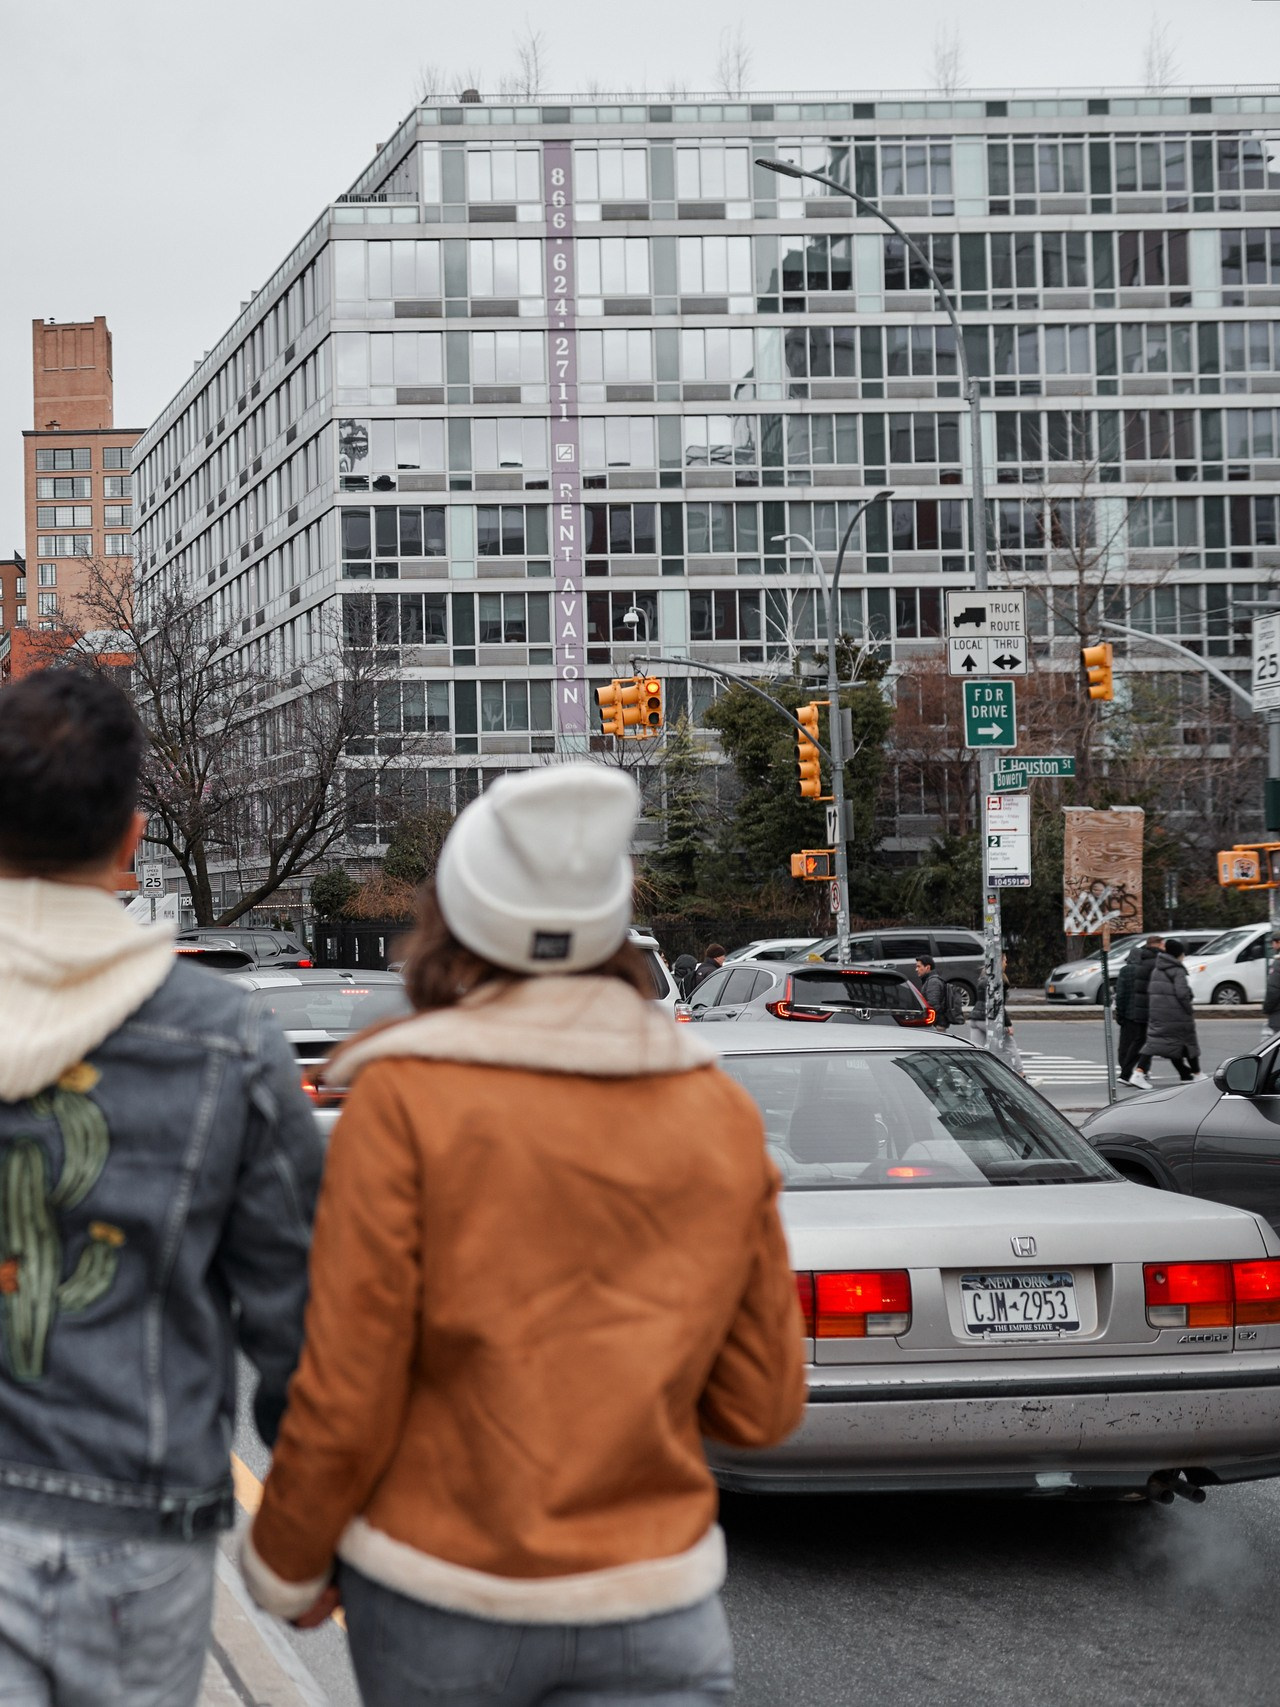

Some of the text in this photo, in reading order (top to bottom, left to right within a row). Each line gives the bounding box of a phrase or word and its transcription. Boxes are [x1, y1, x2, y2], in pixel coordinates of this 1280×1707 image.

[559, 483, 574, 562] RENT
[989, 603, 1020, 613] TRUCK
[990, 621, 1020, 631] ROUTE
[561, 578, 578, 704] AVALON
[954, 640, 983, 650] LOCAL
[994, 639, 1019, 649] THRU
[1257, 653, 1279, 680] 25
[975, 689, 1003, 701] FDR
[972, 705, 1008, 718] DRIVE
[1011, 759, 1059, 774] Houston
[1063, 759, 1072, 769] St
[997, 772, 1023, 788] Bowery
[990, 836, 998, 847] 2
[145, 877, 161, 887] 25
[988, 1276, 1048, 1289] NEW YORK
[1033, 1323, 1053, 1331] STATE
[1177, 1332, 1257, 1343] ACCORD EX
